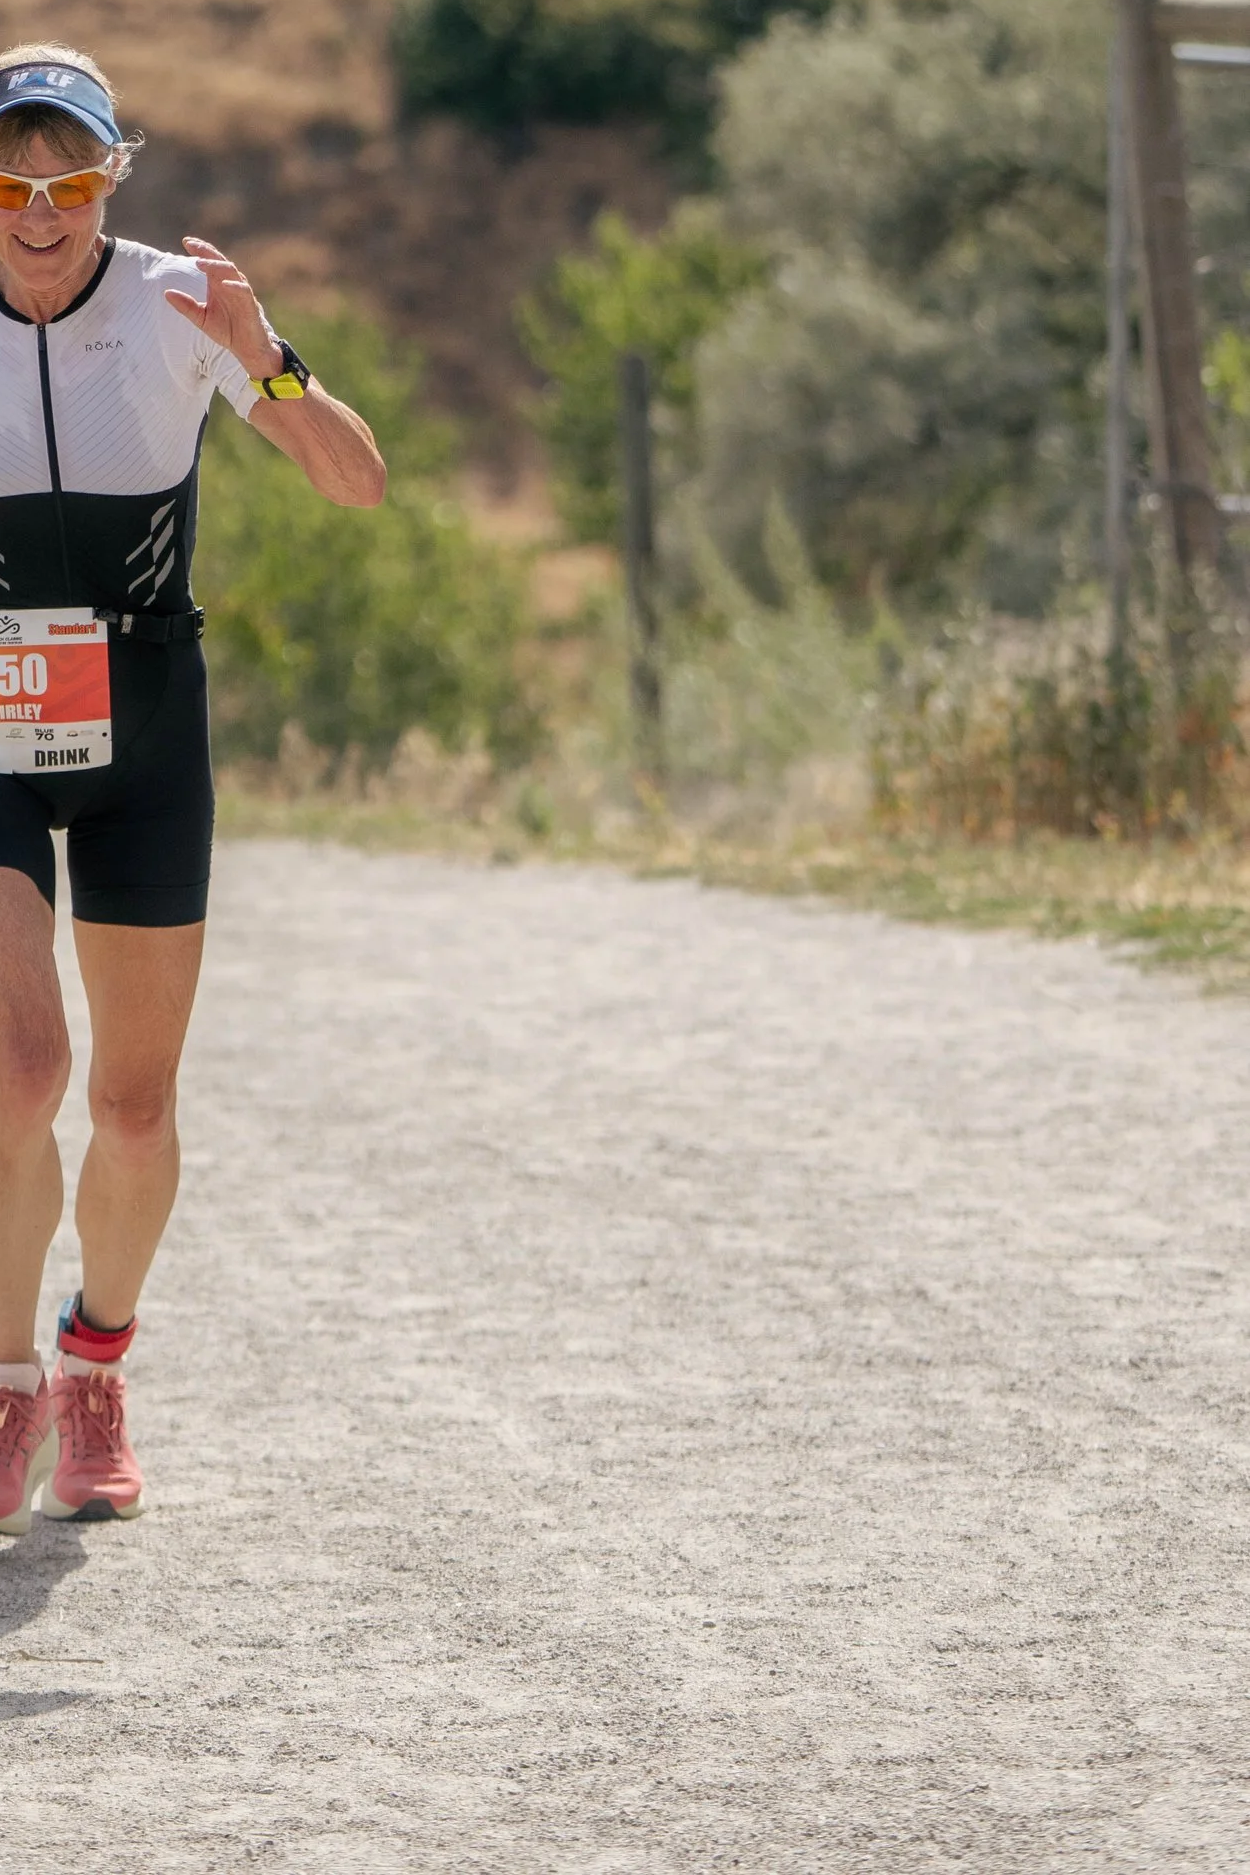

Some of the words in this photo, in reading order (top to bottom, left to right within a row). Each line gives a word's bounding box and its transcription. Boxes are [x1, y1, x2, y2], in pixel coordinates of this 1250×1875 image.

[7, 71, 75, 91] HALF
[48, 622, 97, 636] Standard
[35, 733, 55, 741] 70
[34, 747, 91, 768] DRINK
